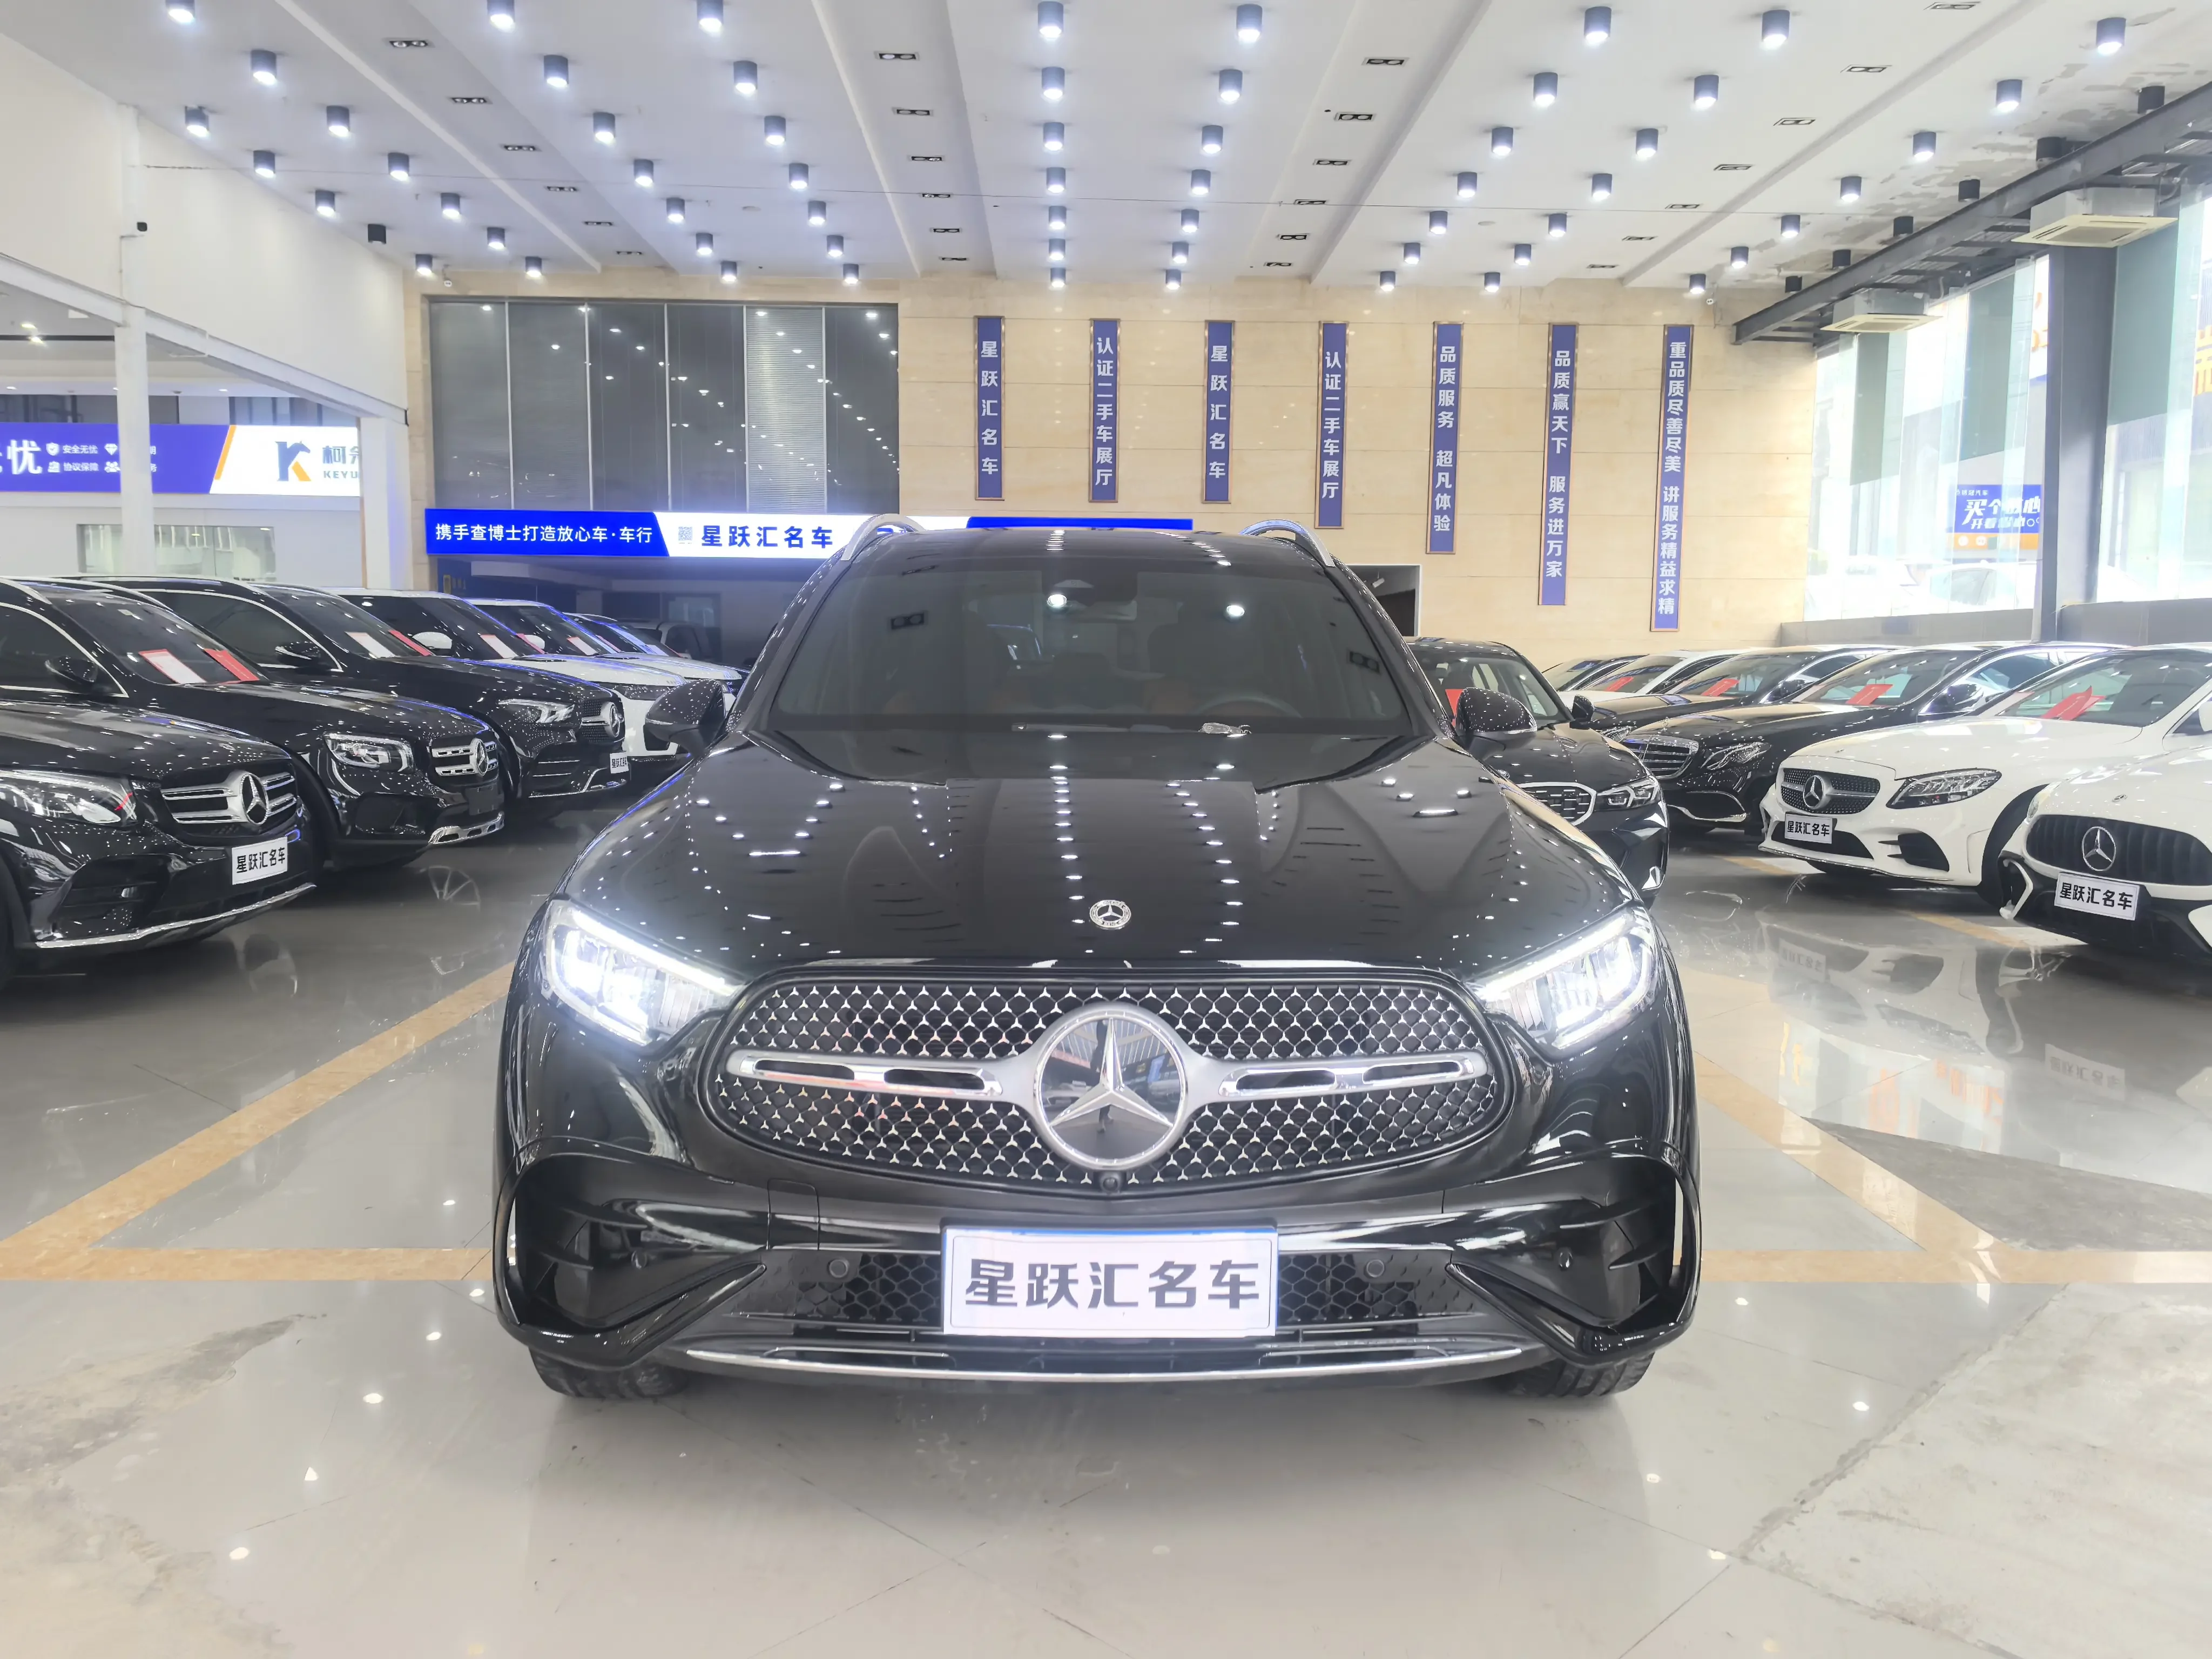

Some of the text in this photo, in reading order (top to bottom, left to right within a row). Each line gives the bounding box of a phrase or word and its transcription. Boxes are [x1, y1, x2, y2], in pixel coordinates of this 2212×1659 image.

[980, 341, 999, 475] 星跃汇名车
[1095, 337, 1114, 485] 认证二手车展厅
[1209, 345, 1229, 478] 星跃汇名车
[1321, 351, 1341, 499] 认证二手车展厅
[0, 439, 43, 475] 忧
[62, 444, 99, 454] 安全无忧
[1433, 346, 1456, 532] 品质服务 超凡体验
[1546, 350, 1571, 578] 品质赢天下 服务进万家
[1657, 341, 1687, 615] 重品质尽善尽美 讲服务精益求精
[435, 523, 653, 543] 携手查博士打造放心车·车行
[701, 525, 833, 549] 星跃汇名车
[1787, 820, 1830, 837] 星跃汇名车
[236, 847, 285, 874] 星跃汇名车
[2059, 882, 2133, 910] 星跃汇名车
[965, 1258, 1260, 1310] 星跃汇名车
